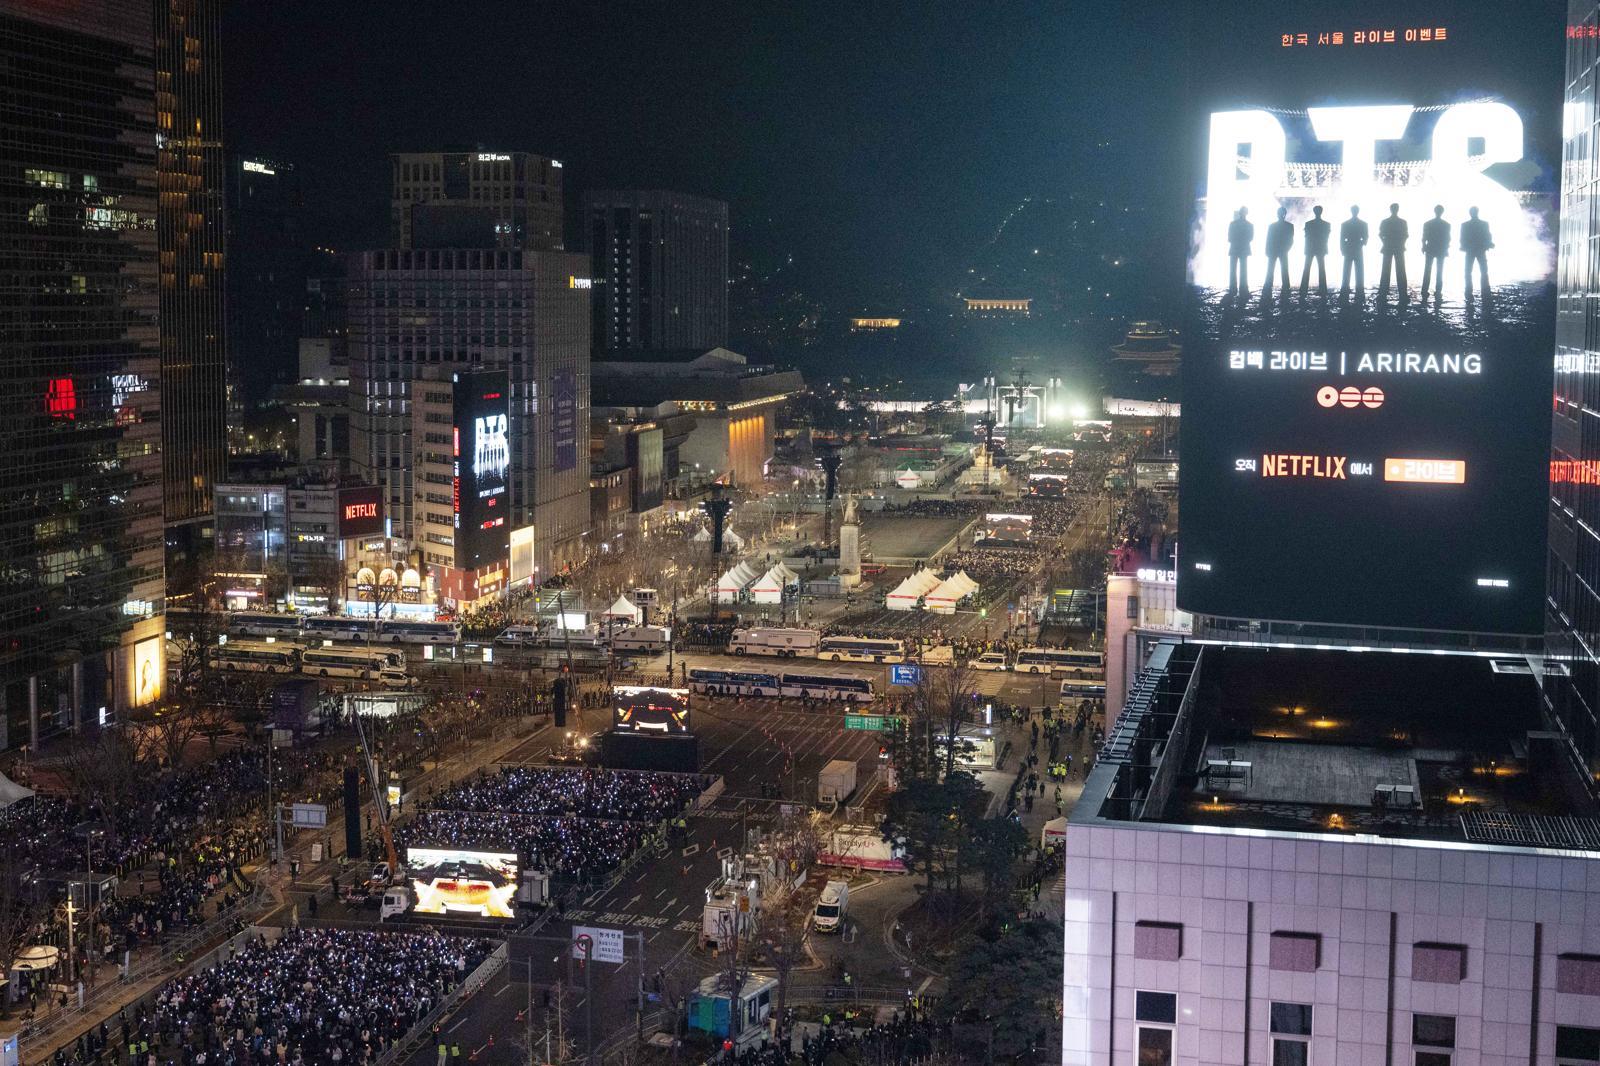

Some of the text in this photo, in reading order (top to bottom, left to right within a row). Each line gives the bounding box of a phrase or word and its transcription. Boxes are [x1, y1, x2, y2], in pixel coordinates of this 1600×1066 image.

[1282, 28, 1446, 47] 한국 서울 라이브 이벤트
[1229, 351, 1482, 374] 컴백 라이브 ARIRANG
[1234, 454, 1457, 480] 오직 NETFLIX 에서 라이브
[346, 503, 376, 520] NETFLIX
